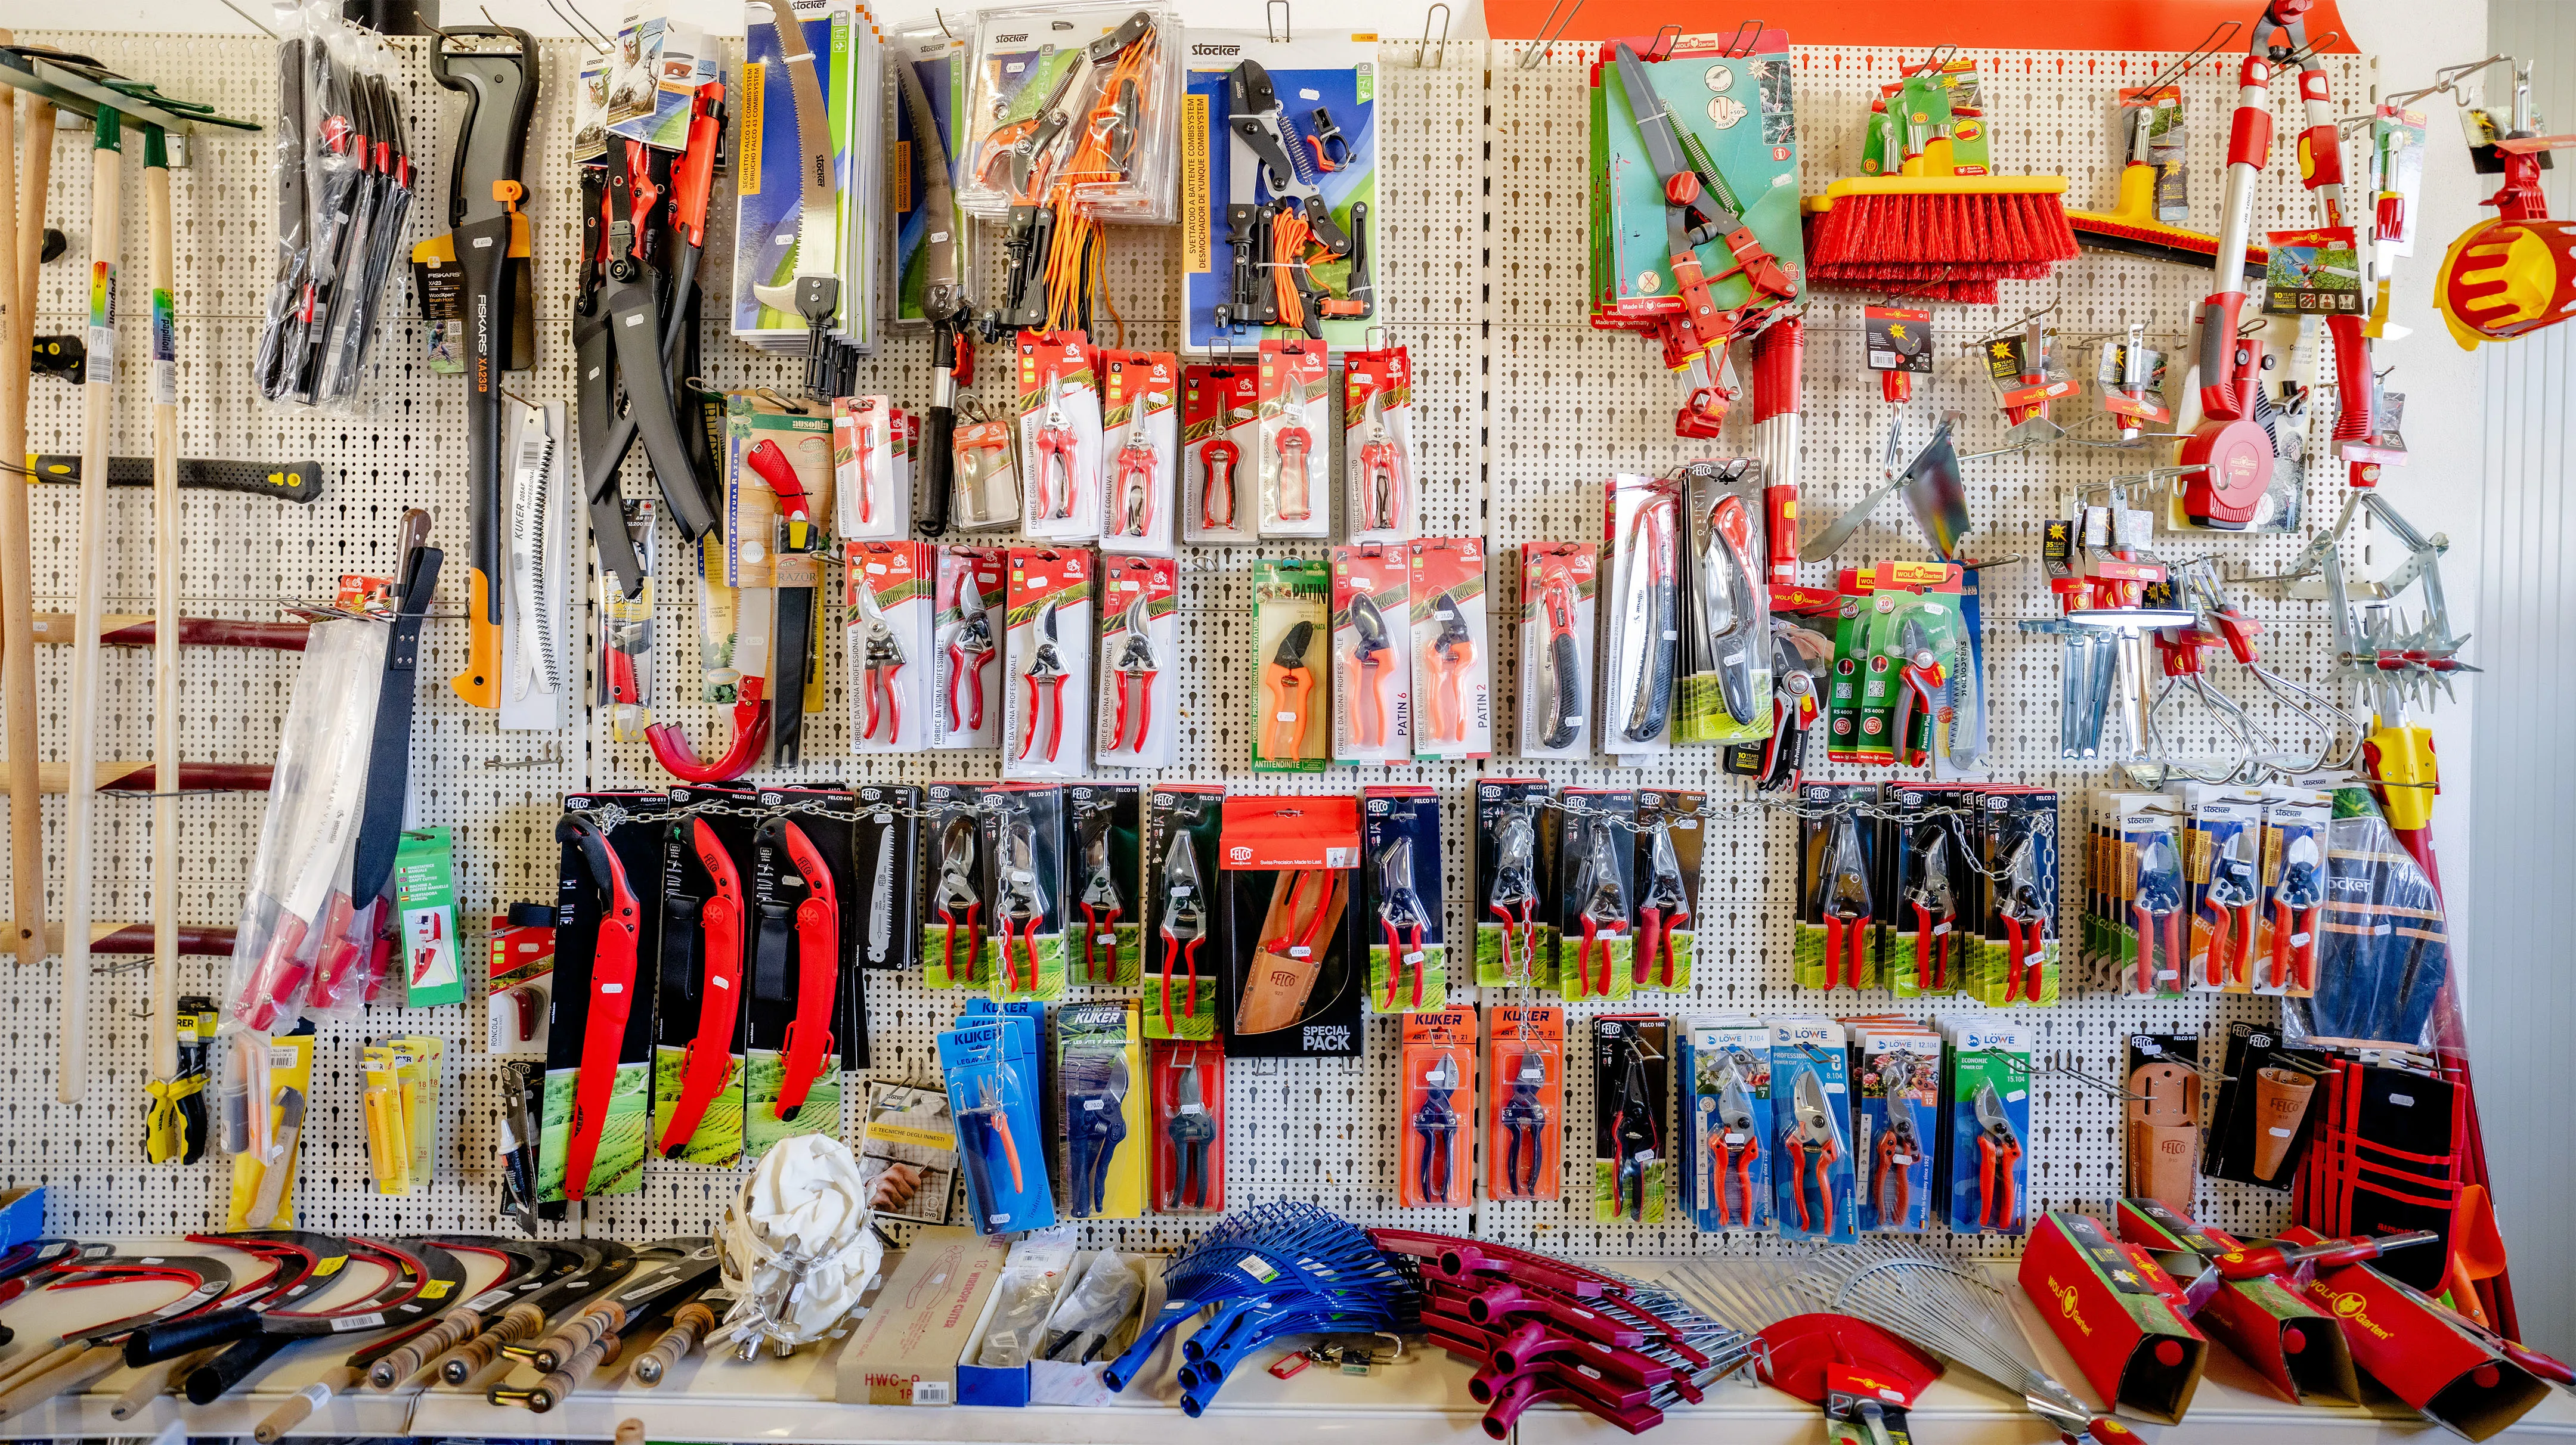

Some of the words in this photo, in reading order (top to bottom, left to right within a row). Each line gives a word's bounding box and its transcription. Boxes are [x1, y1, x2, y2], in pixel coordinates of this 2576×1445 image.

[996, 34, 1028, 42] Stocker
[921, 44, 945, 52] Stocker
[1192, 43, 1240, 55] Stocker
[1199, 194, 1205, 203] DE
[160, 317, 171, 354] papillon
[515, 504, 524, 539] KUKER
[778, 572, 818, 582] RAZOR
[1293, 584, 1326, 603] PATIN
[854, 710, 860, 719] DA
[1478, 694, 1487, 727] PATIN
[1398, 703, 1407, 735] PATIN
[672, 789, 689, 801] FELCO
[862, 788, 880, 800] FELCO
[931, 786, 949, 798] FELCO
[1073, 787, 1091, 799] FELCO
[1482, 786, 1500, 797] FELCO
[1811, 787, 1829, 799] FELCO
[568, 798, 588, 808] FELCO
[761, 793, 781, 805] FELCO
[1154, 793, 1173, 806] FELCO
[1987, 797, 2007, 809] FELCO
[1368, 799, 1388, 812] FELCO
[1231, 847, 1252, 860] FELCO
[1271, 971, 1295, 986] FELCO
[983, 1003, 1027, 1013] KUKER
[1075, 1012, 1120, 1023] KUKER
[1416, 1015, 1462, 1025] KUKER
[1304, 1026, 1347, 1036] SPECIAL
[1602, 1022, 1621, 1034] FELCO
[1795, 1029, 1827, 1038] LÖWE
[1304, 1035, 1349, 1050] PACK
[1984, 1035, 2014, 1044] LÖWE
[2250, 1035, 2270, 1047] FELCO
[957, 1055, 990, 1065] LEGAVITE
[2270, 1098, 2299, 1112] FELCO
[2162, 1140, 2185, 1154] FELCO
[1029, 1184, 1042, 1218] Traditional
[2047, 1275, 2064, 1300] WOLF
[2073, 1310, 2089, 1337] Garten
[2309, 1278, 2336, 1300] WOLF
[2355, 1313, 2386, 1339] Garten
[945, 1305, 964, 1328] CUTTER
[865, 1374, 919, 1387] HWC-9
